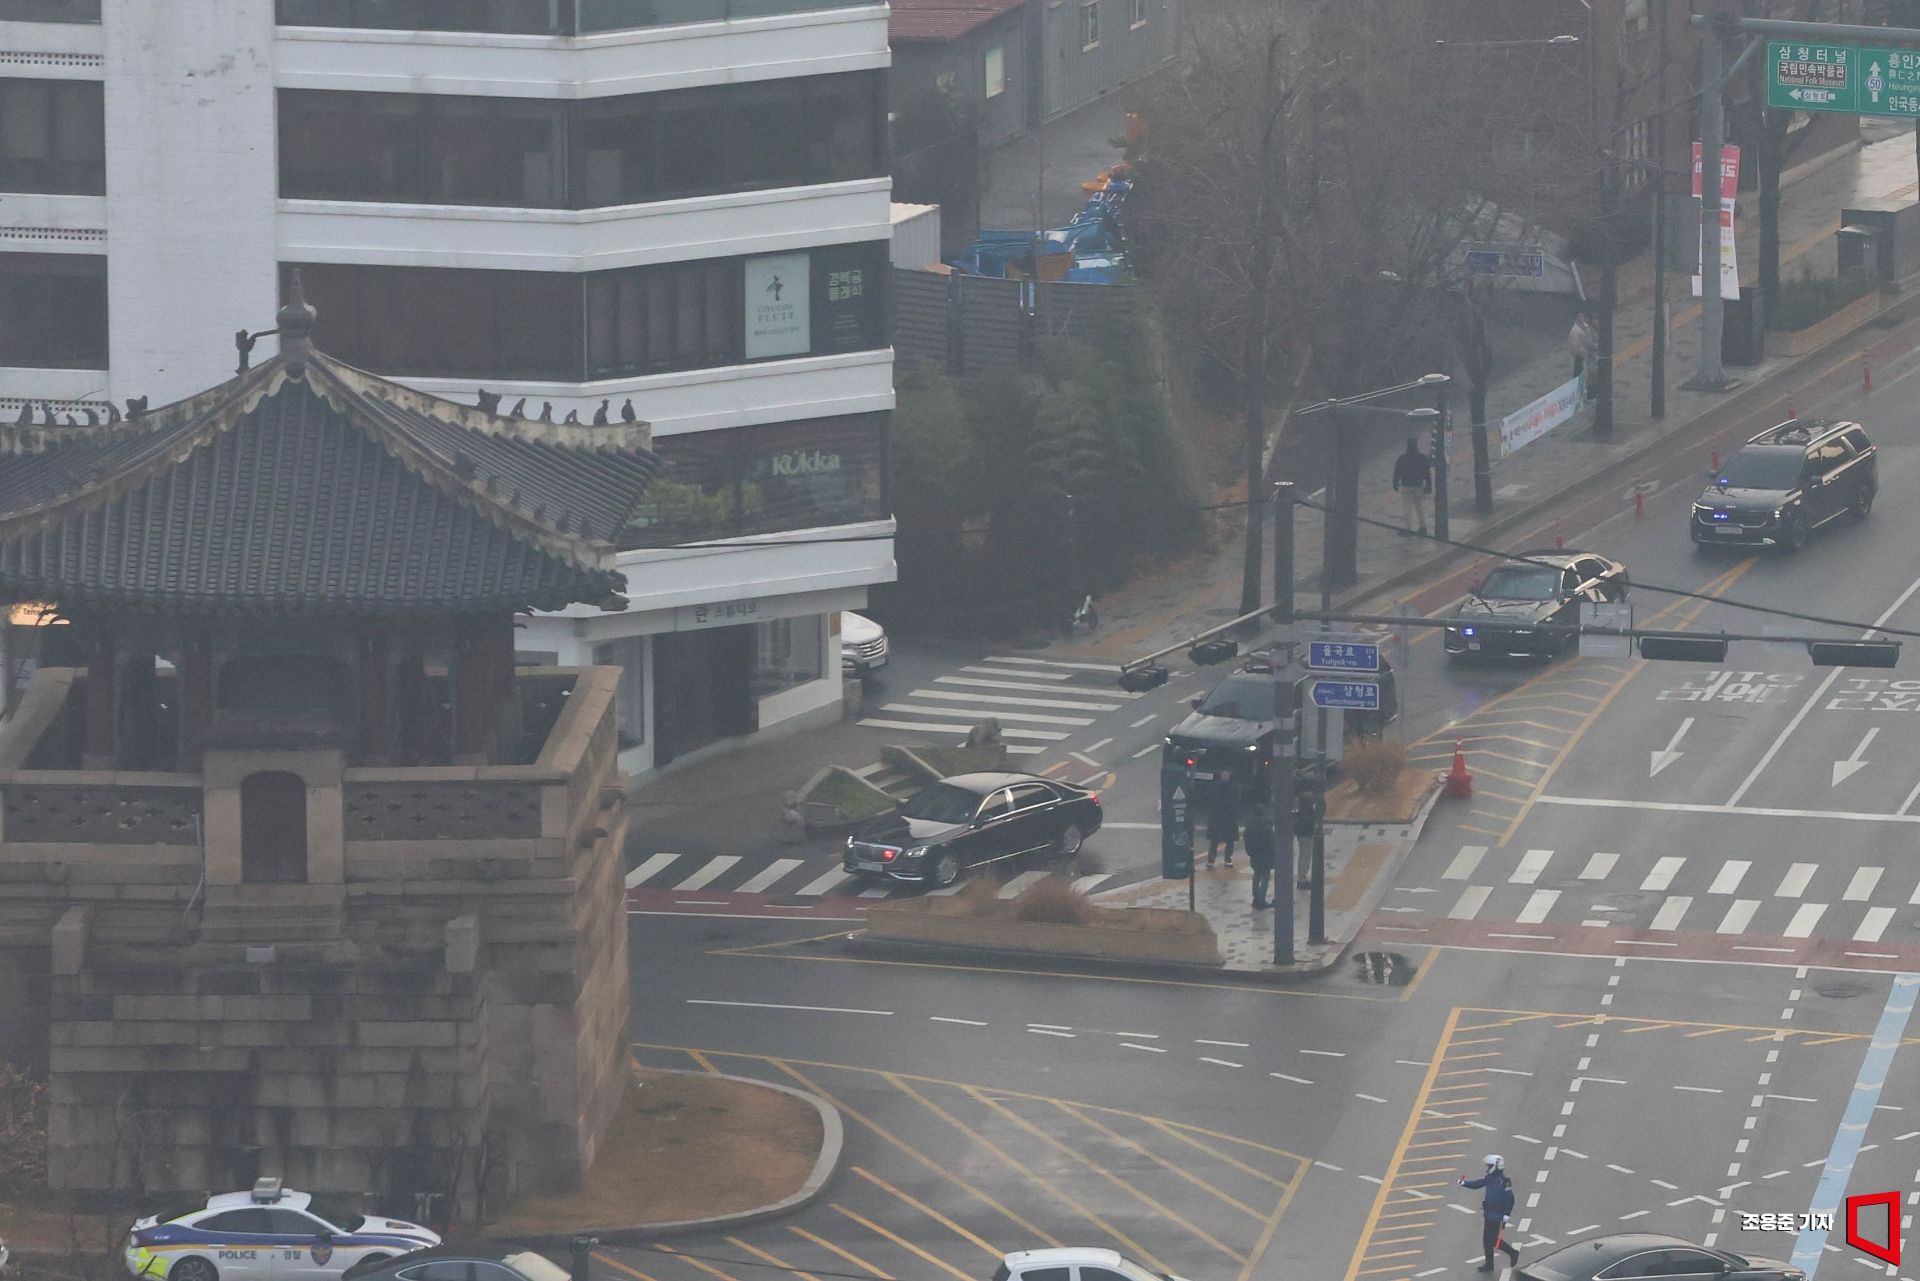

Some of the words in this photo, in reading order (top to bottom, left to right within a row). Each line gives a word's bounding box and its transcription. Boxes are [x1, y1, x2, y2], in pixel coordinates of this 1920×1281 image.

[1779, 45, 1846, 64] 삼청터널
[1780, 62, 1845, 78] 국립민속박물관
[1869, 78, 1881, 90] 50
[1889, 96, 1920, 112] 안국동
[218, 1250, 257, 1260] POLICE
